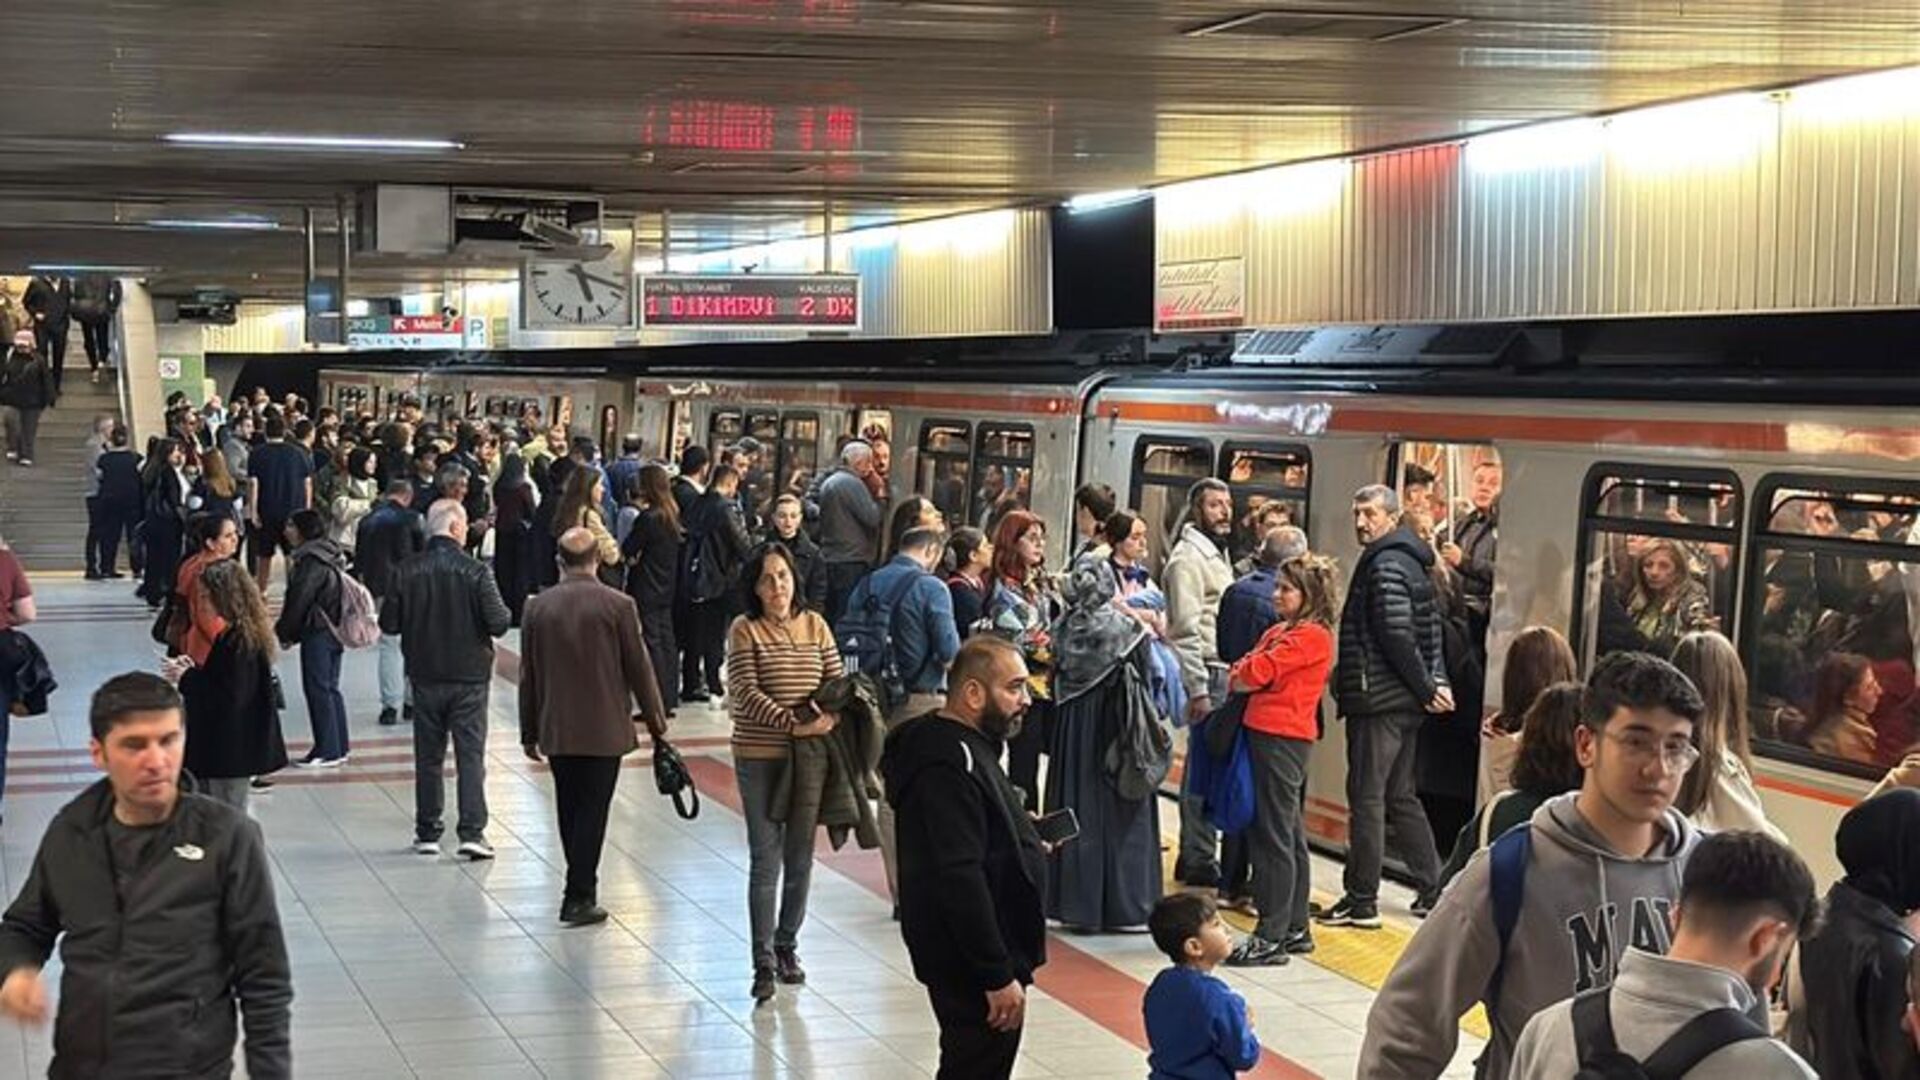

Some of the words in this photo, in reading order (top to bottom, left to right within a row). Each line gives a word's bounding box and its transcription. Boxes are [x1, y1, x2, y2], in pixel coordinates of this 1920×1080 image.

[647, 296, 659, 315] 1
[801, 297, 815, 315] 2
[826, 297, 854, 315] DK
